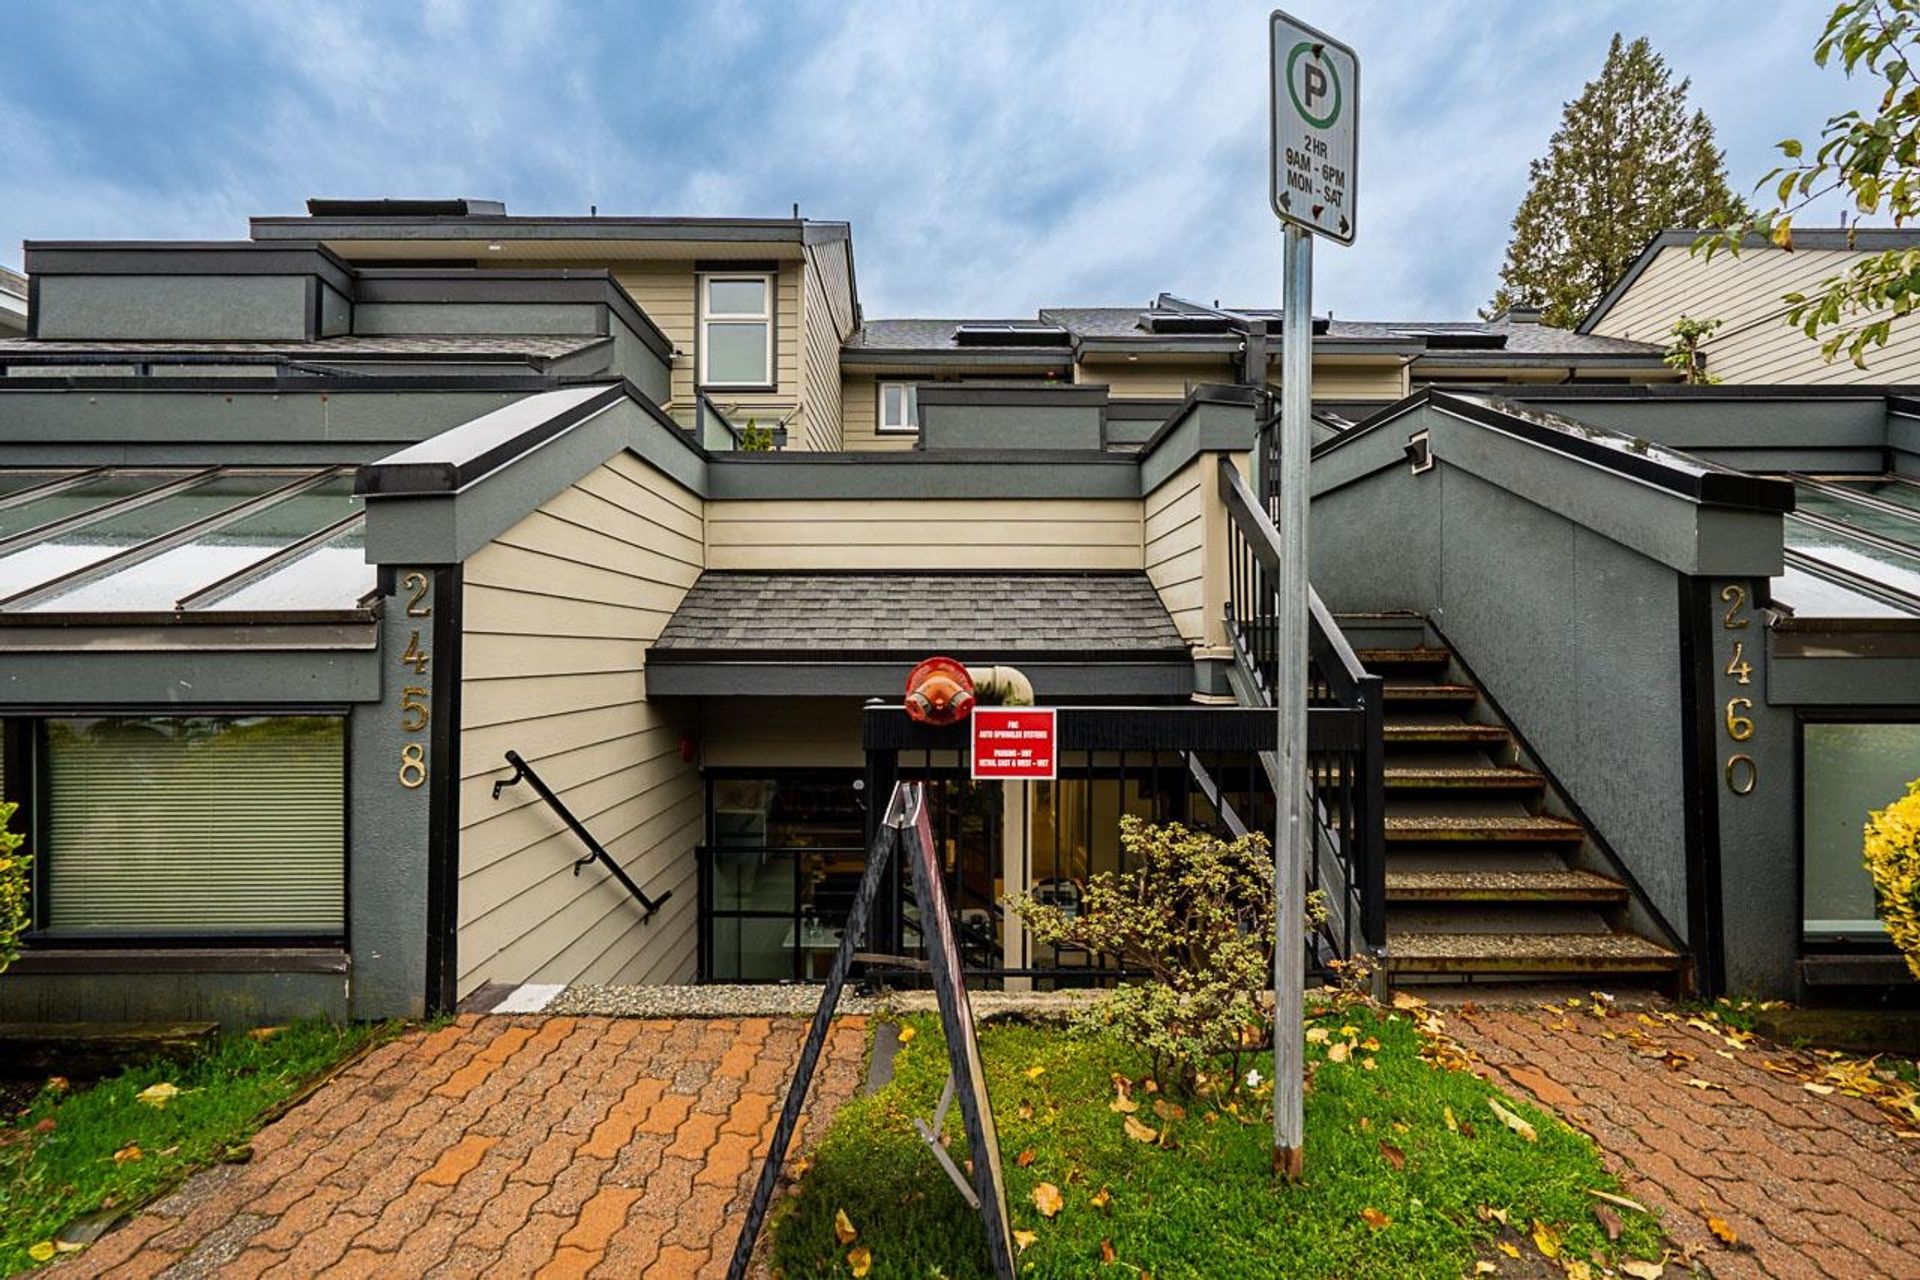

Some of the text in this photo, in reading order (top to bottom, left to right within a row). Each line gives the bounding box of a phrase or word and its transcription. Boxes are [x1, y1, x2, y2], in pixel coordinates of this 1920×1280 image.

[1305, 62, 1327, 108] P
[1286, 147, 1311, 173] 9AM
[1322, 164, 1345, 189] 6PM
[1287, 169, 1313, 195] MON
[1323, 185, 1343, 208] SAT
[399, 571, 431, 788] 2458
[1722, 585, 1757, 796] 2460
[994, 731, 1022, 739] SPRINKLER
